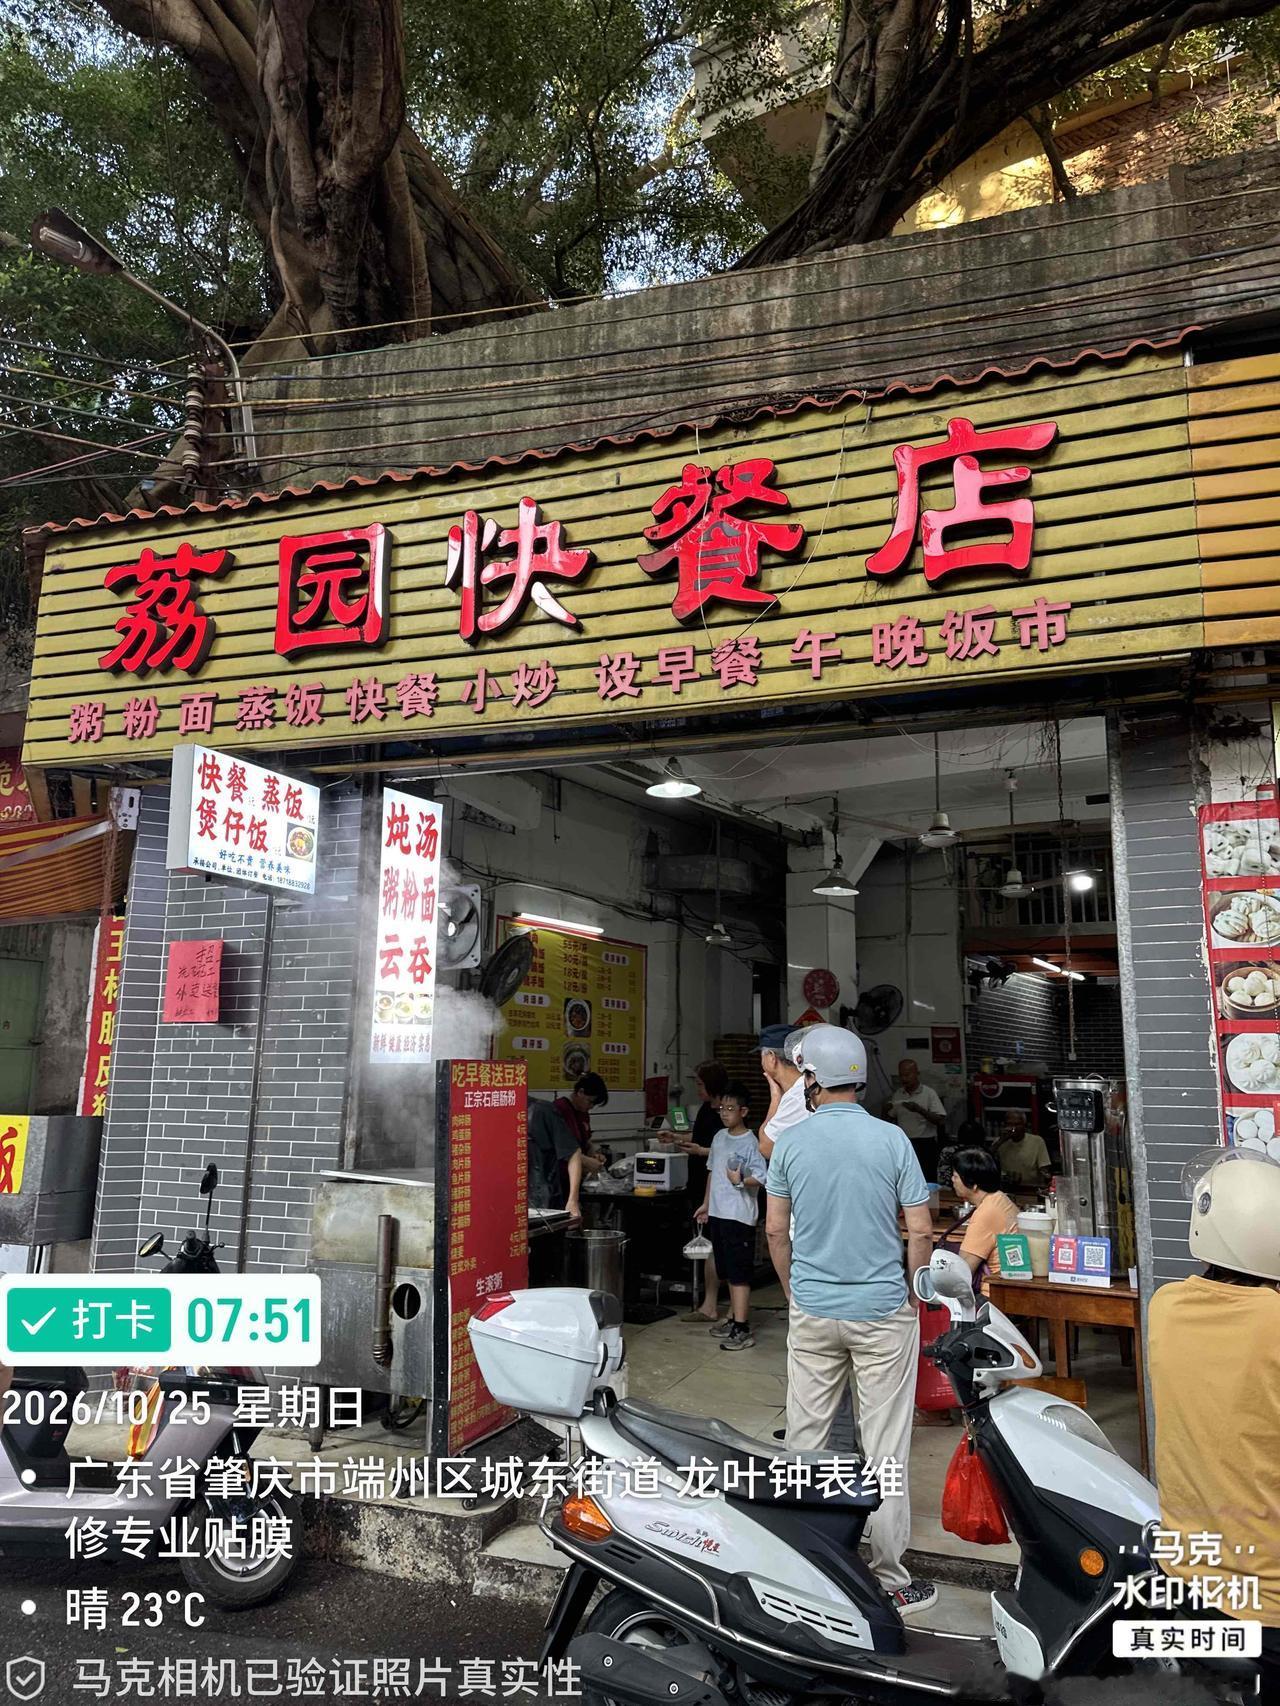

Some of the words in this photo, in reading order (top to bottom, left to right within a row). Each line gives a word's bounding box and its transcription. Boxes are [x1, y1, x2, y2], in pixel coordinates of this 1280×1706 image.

[97, 416, 1060, 676] 荔园快餐店
[197, 752, 249, 803] 快餐
[261, 774, 305, 820] 蒸饭
[196, 796, 269, 853] 煲仔饭
[385, 801, 439, 862] 炖汤
[382, 866, 436, 924] 粥粉面
[379, 934, 432, 984] 云吞
[452, 1063, 527, 1088] 吃早餐送豆浆
[464, 1090, 516, 1108] 正宗石磨肠粉
